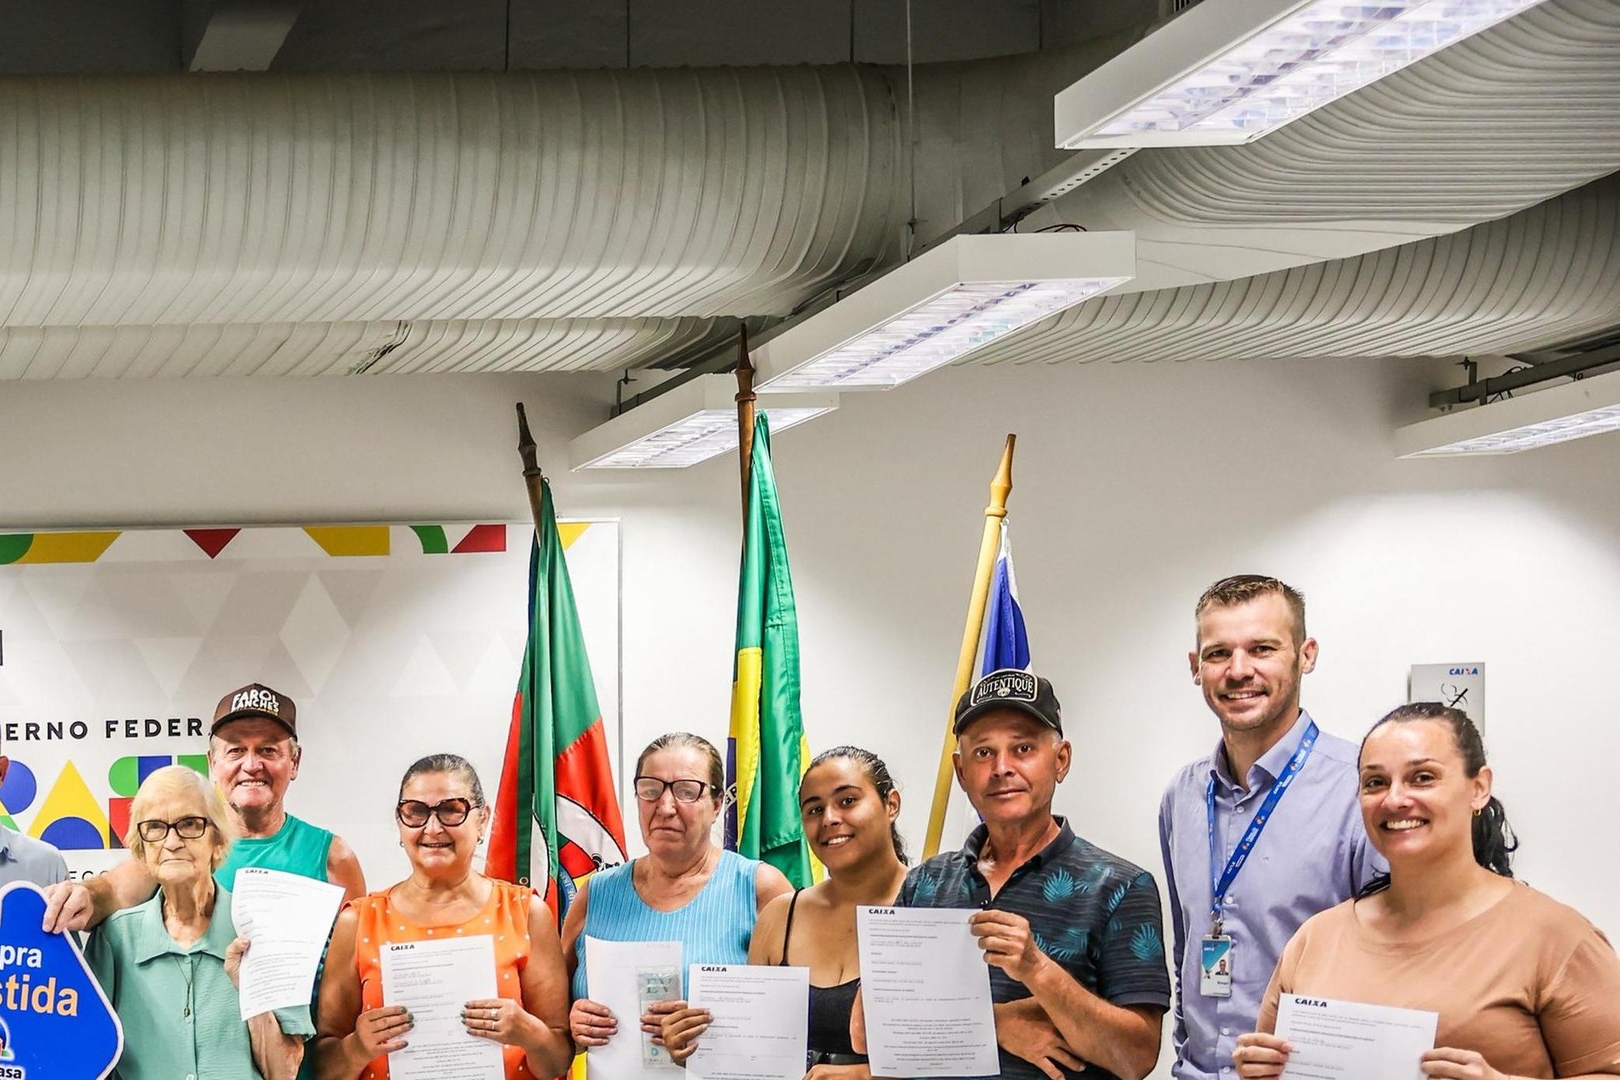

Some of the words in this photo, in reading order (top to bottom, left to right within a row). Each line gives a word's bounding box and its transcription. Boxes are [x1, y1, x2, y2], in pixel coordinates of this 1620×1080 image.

[1449, 667, 1478, 676] CAIXA
[976, 677, 1034, 699] AUTENTIQUE
[233, 689, 276, 706] FAROL
[5, 720, 89, 742] ERNO
[105, 718, 213, 739] FEDER
[1294, 997, 1328, 1008] CAIXA
